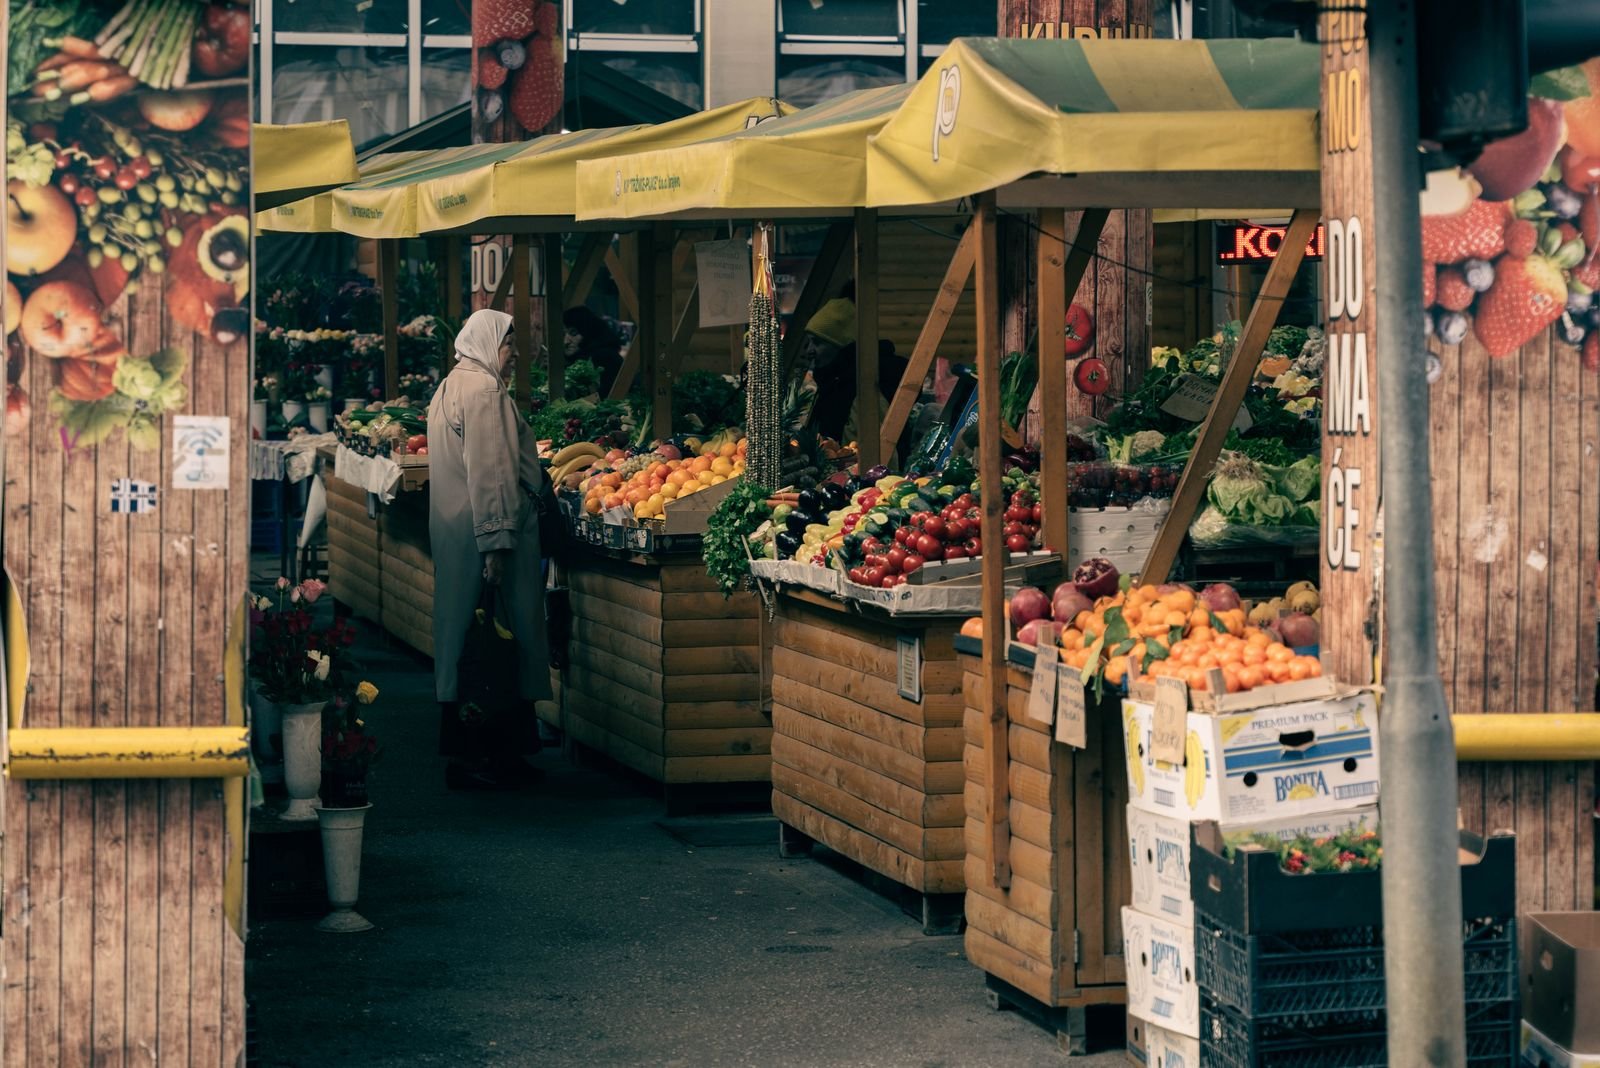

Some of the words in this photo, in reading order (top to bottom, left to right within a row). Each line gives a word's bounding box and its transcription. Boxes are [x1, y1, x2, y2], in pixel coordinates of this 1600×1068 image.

[1327, 67, 1361, 153] MO
[1328, 215, 1363, 321] DO
[1328, 332, 1371, 436] MA
[1326, 447, 1361, 571] ĆE
[1251, 715, 1300, 730] PREMIUM
[1303, 711, 1329, 725] PACK
[1273, 770, 1330, 802] BONITA
[1155, 838, 1187, 882] BONITA
[1150, 939, 1183, 985] BONITA
